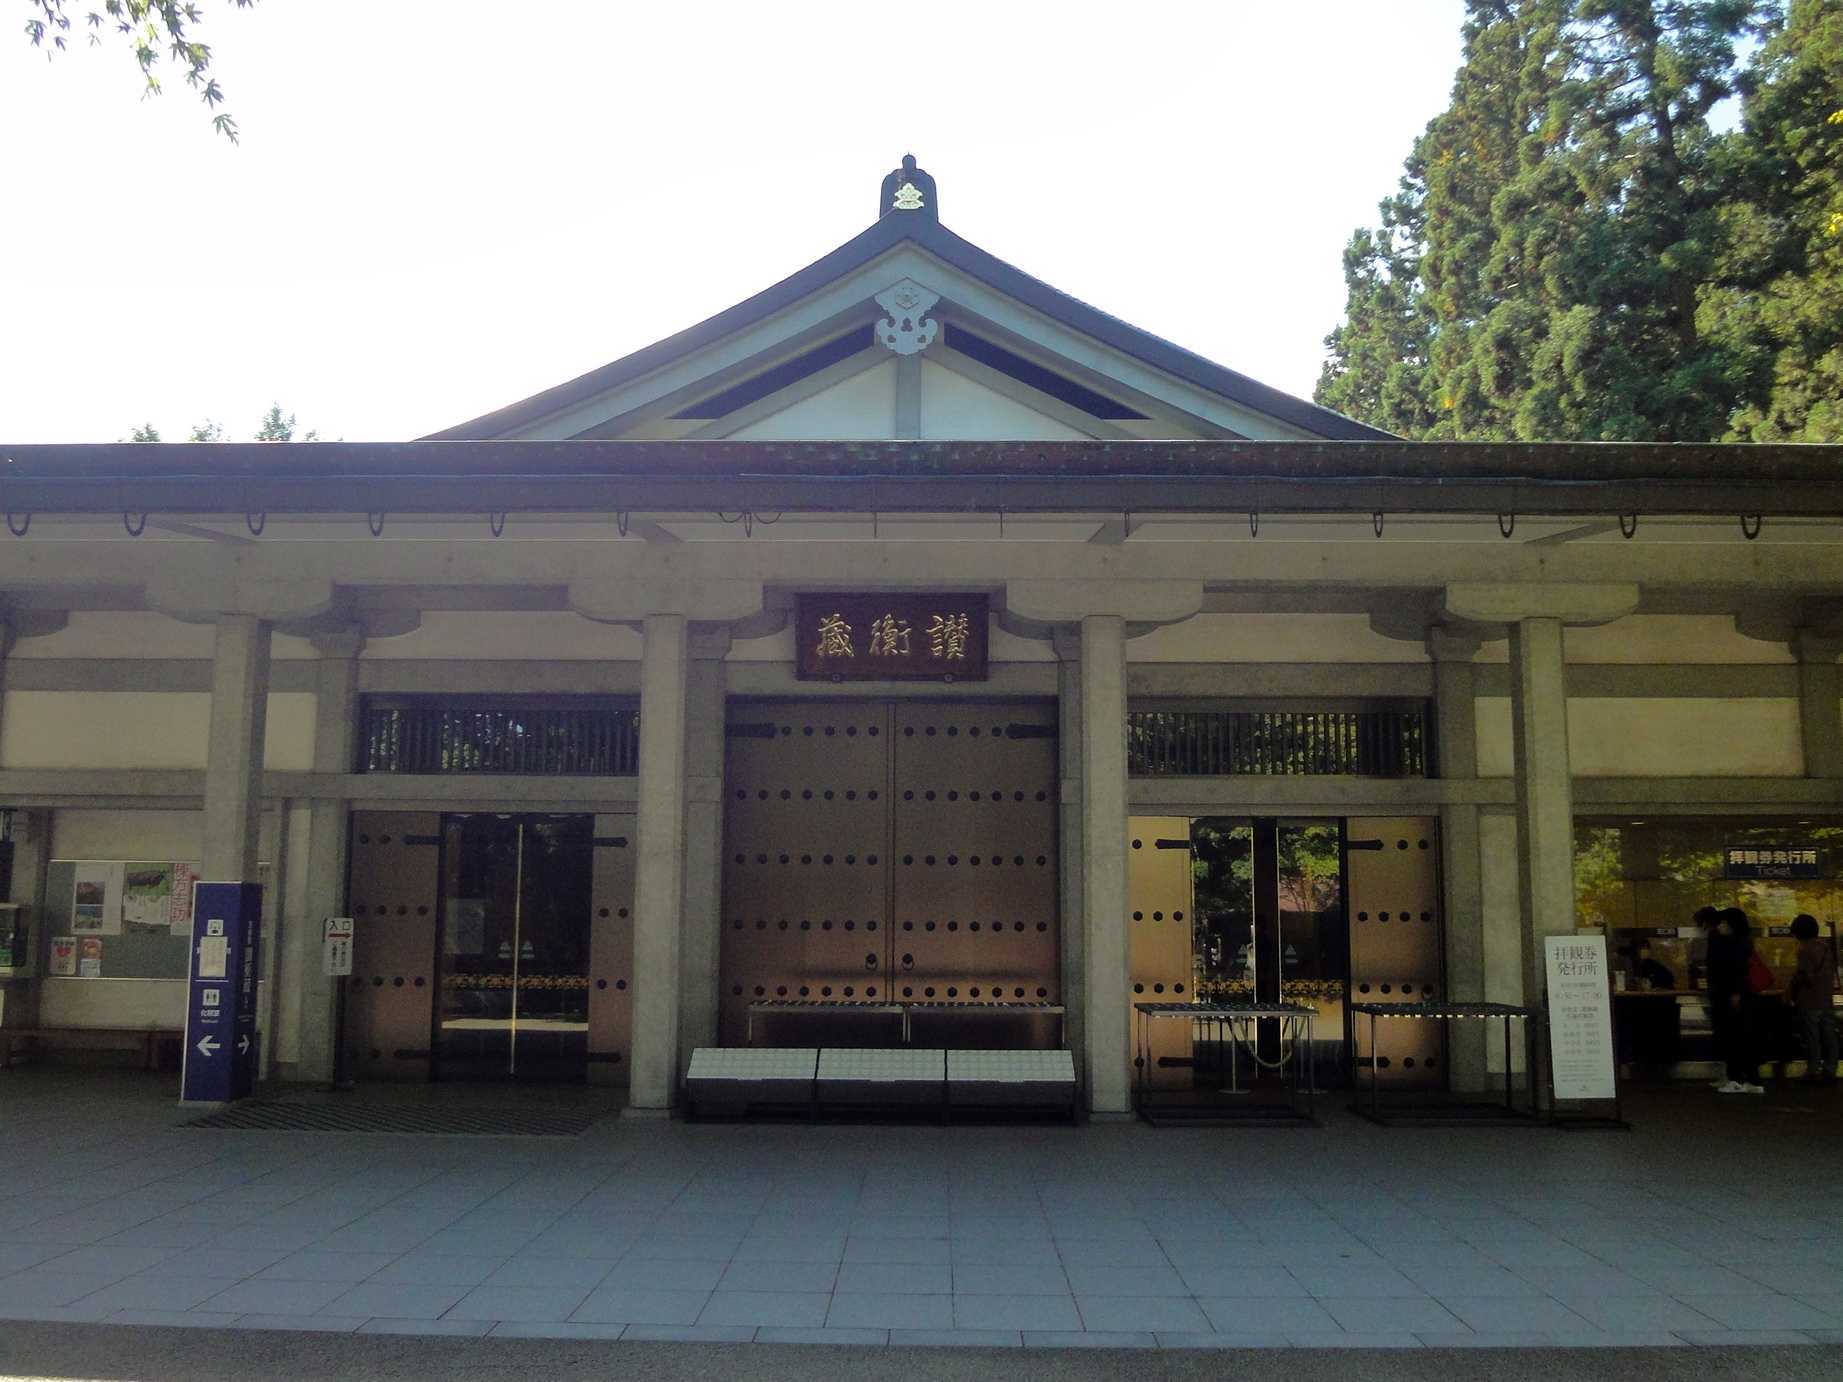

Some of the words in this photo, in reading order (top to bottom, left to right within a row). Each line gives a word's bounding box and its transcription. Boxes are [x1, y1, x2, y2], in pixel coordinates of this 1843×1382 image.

[328, 919, 352, 931] 入口
[1553, 944, 1598, 960] 拝観券
[1557, 961, 1598, 976] 発行所
